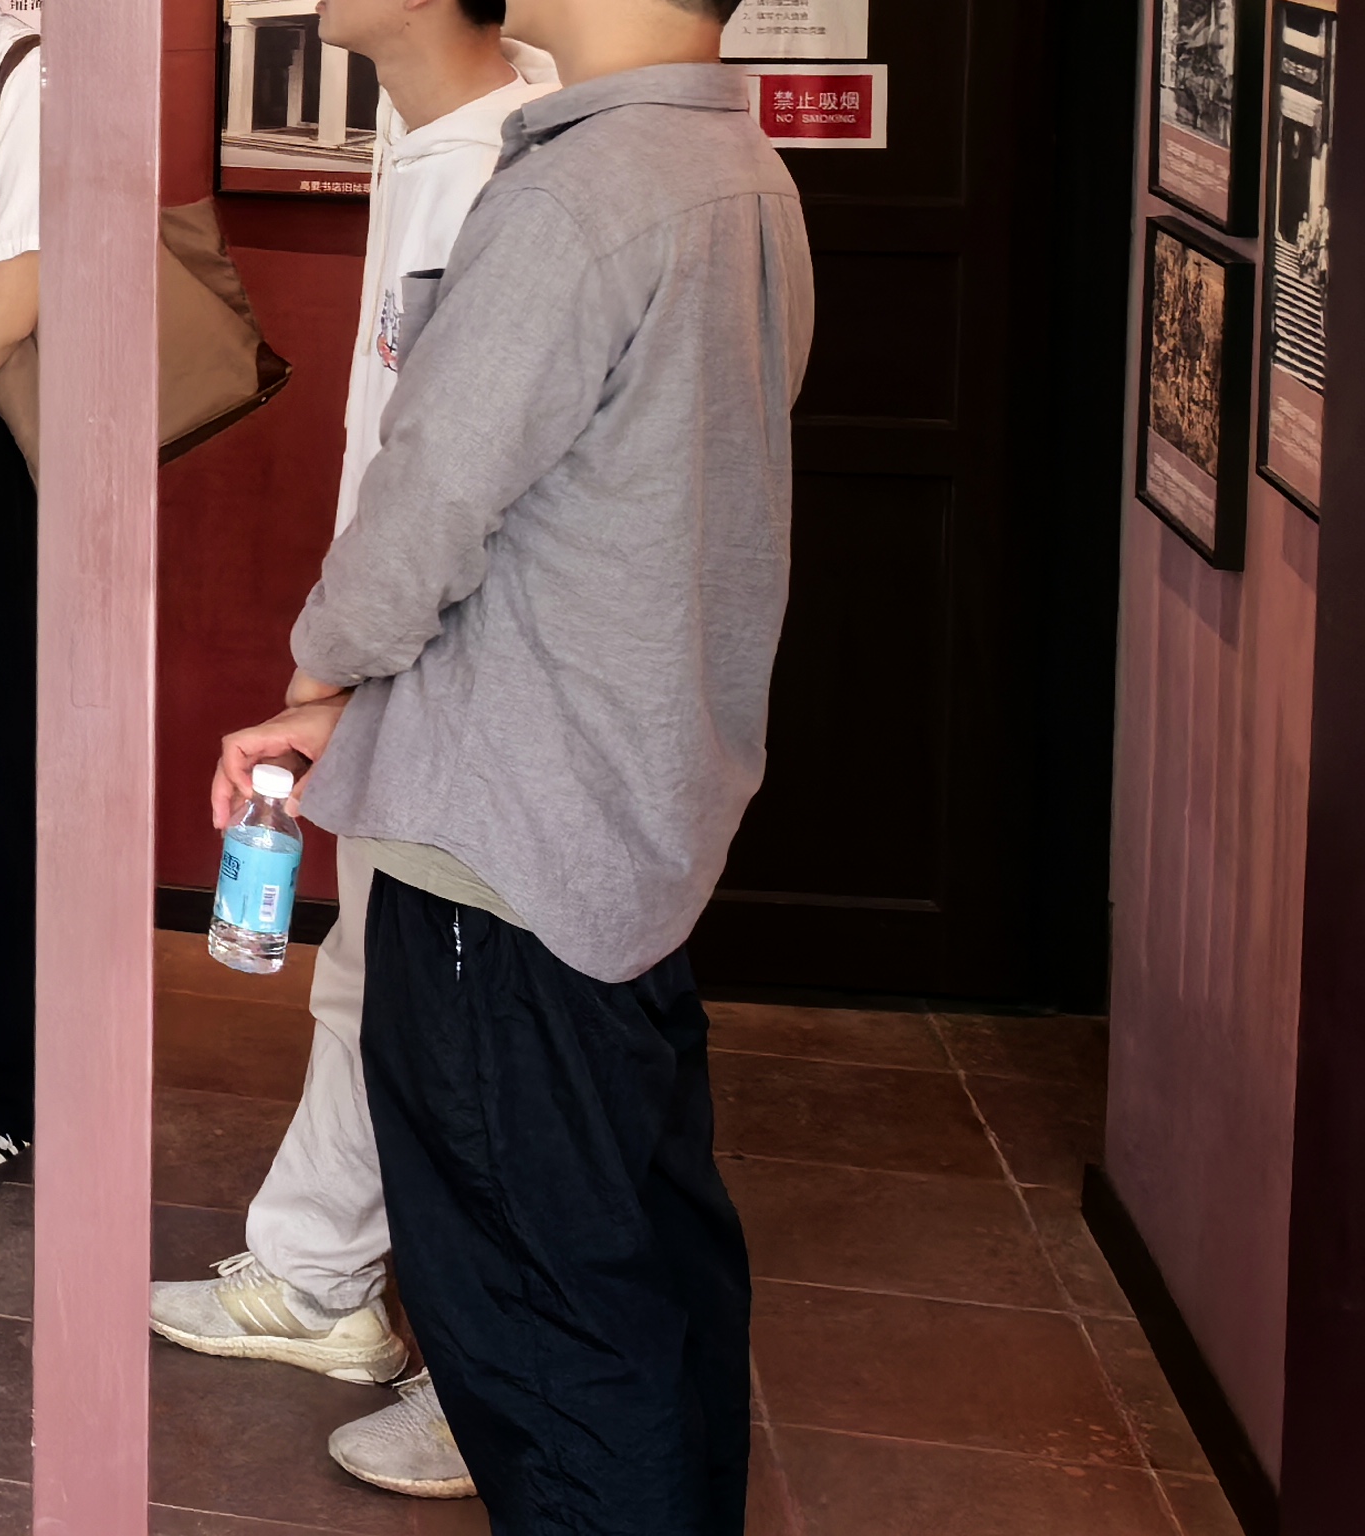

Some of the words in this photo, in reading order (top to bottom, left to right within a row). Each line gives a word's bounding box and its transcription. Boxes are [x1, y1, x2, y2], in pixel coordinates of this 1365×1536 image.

[773, 90, 860, 111] 禁止吸烟
[776, 113, 794, 123] NO
[802, 114, 857, 124] SMOKING
